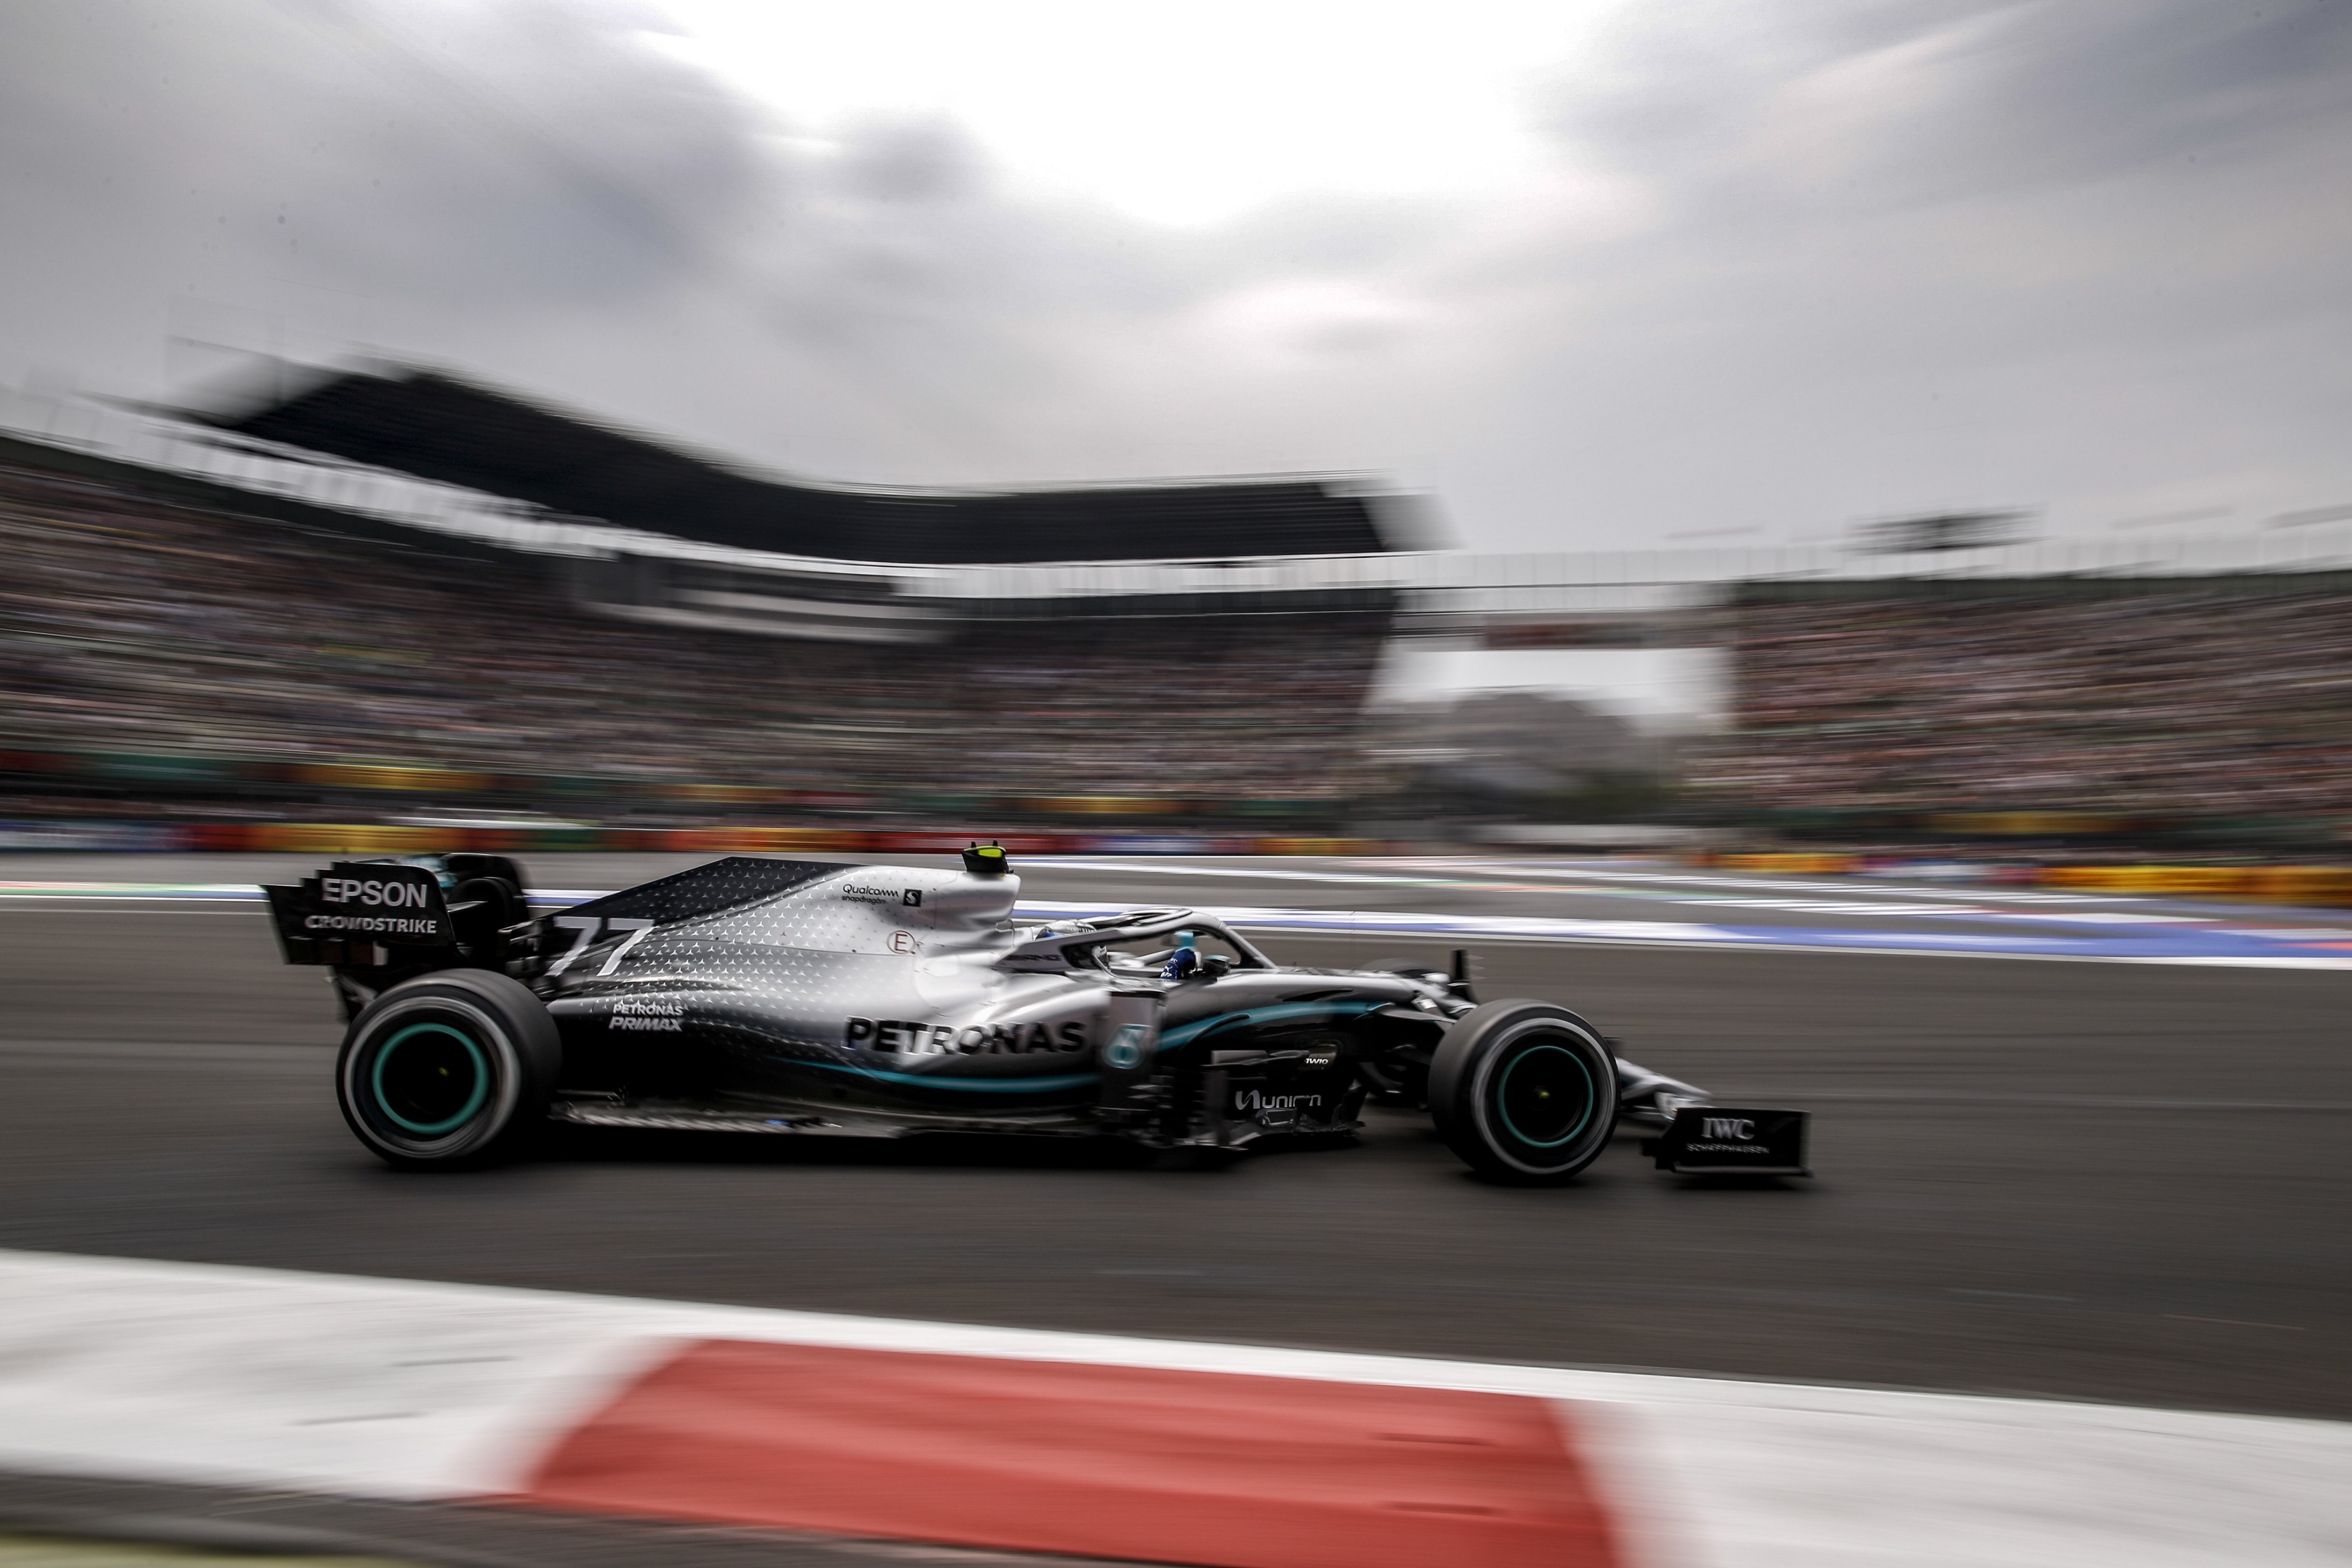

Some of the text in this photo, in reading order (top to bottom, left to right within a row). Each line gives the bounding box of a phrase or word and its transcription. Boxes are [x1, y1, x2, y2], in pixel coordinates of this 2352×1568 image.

[322, 878, 427, 908] EPSON
[843, 883, 899, 898] Qualcomm
[304, 915, 437, 934] CROWDSTRIKE
[543, 916, 656, 977] 77
[613, 1002, 684, 1016] PETRONAS
[609, 1017, 683, 1032] PRIMAX
[841, 1015, 1089, 1055] PETRONAS
[1700, 1117, 1755, 1140] IWC
